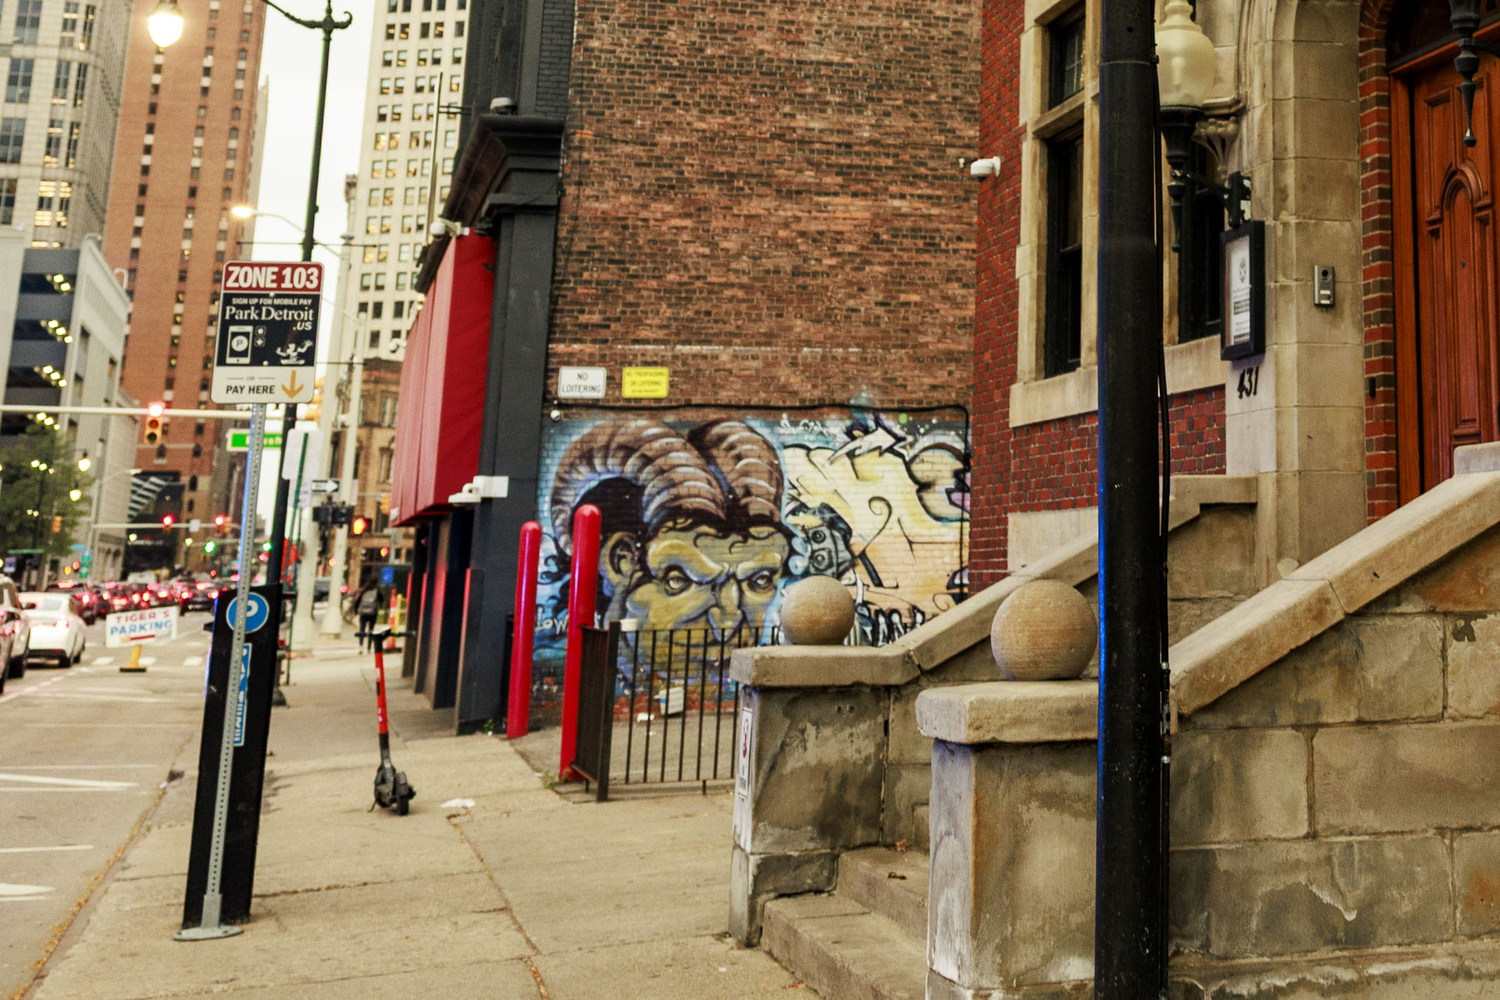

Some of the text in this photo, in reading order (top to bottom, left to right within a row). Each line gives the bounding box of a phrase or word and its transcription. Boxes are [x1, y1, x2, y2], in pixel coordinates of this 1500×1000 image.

[226, 266, 319, 289] ZONE 103
[232, 297, 248, 305] SIGN
[274, 298, 299, 306] MOBILE
[299, 298, 312, 306] PAY
[576, 372, 588, 381] NO
[1237, 366, 1260, 399] 431
[226, 385, 275, 394] PAY HERE
[561, 384, 602, 394] LOITERING
[115, 609, 171, 624] TIGER'S
[110, 619, 173, 636] PARKING
